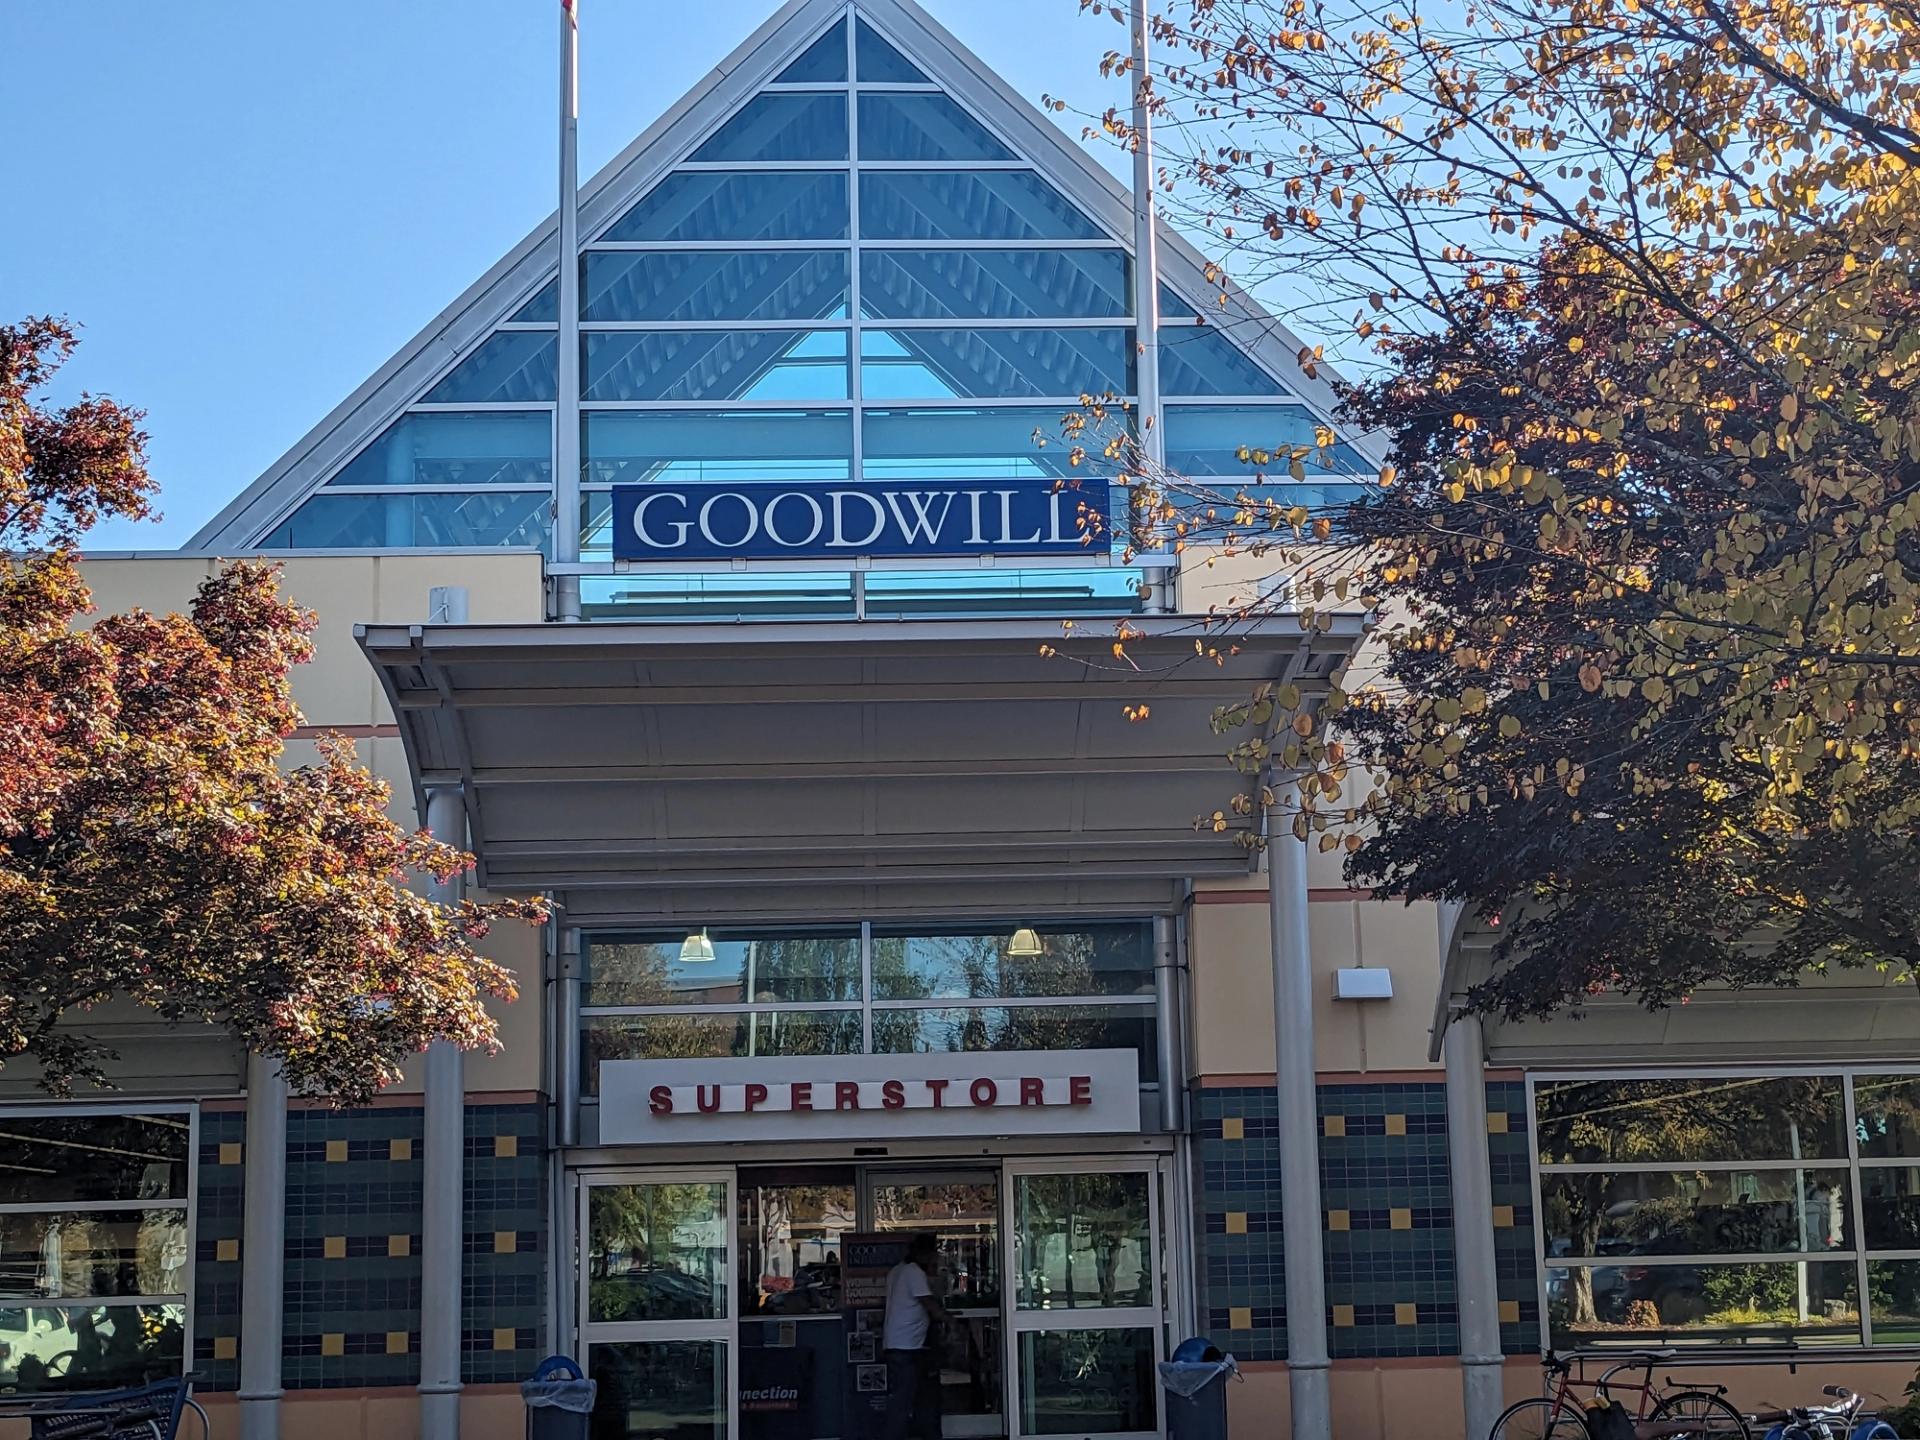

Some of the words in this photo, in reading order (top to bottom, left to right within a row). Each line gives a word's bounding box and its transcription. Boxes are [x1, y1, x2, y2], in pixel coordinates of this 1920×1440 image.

[632, 490, 1091, 548] GOODWILL
[649, 1075, 1093, 1116] SUPERSTORE
[739, 1386, 798, 1400] nection
